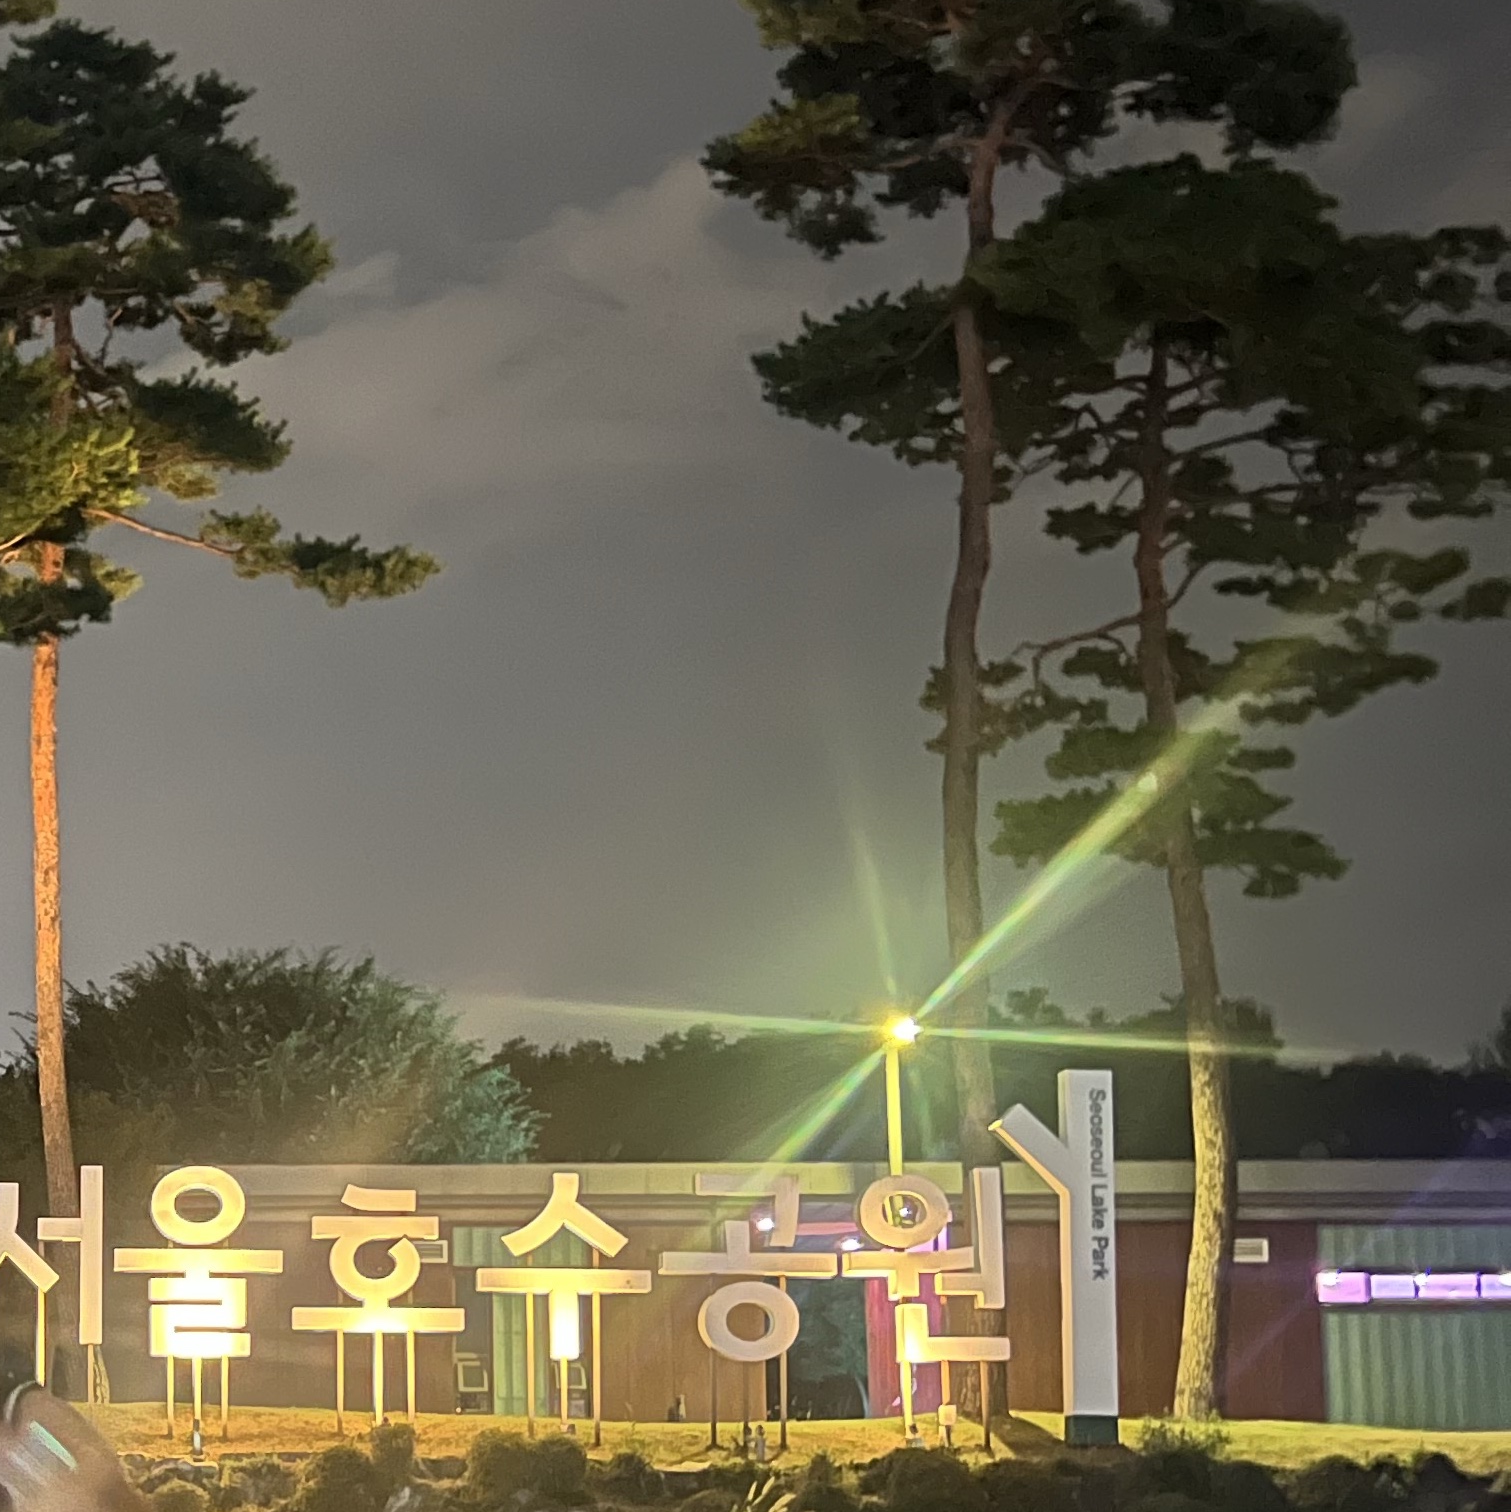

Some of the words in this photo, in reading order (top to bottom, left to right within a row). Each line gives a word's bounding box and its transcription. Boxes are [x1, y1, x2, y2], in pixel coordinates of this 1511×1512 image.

[1089, 1088, 1107, 1178] Seoseoul
[1091, 1184, 1108, 1230] Lake
[1091, 1236, 1110, 1281] Park
